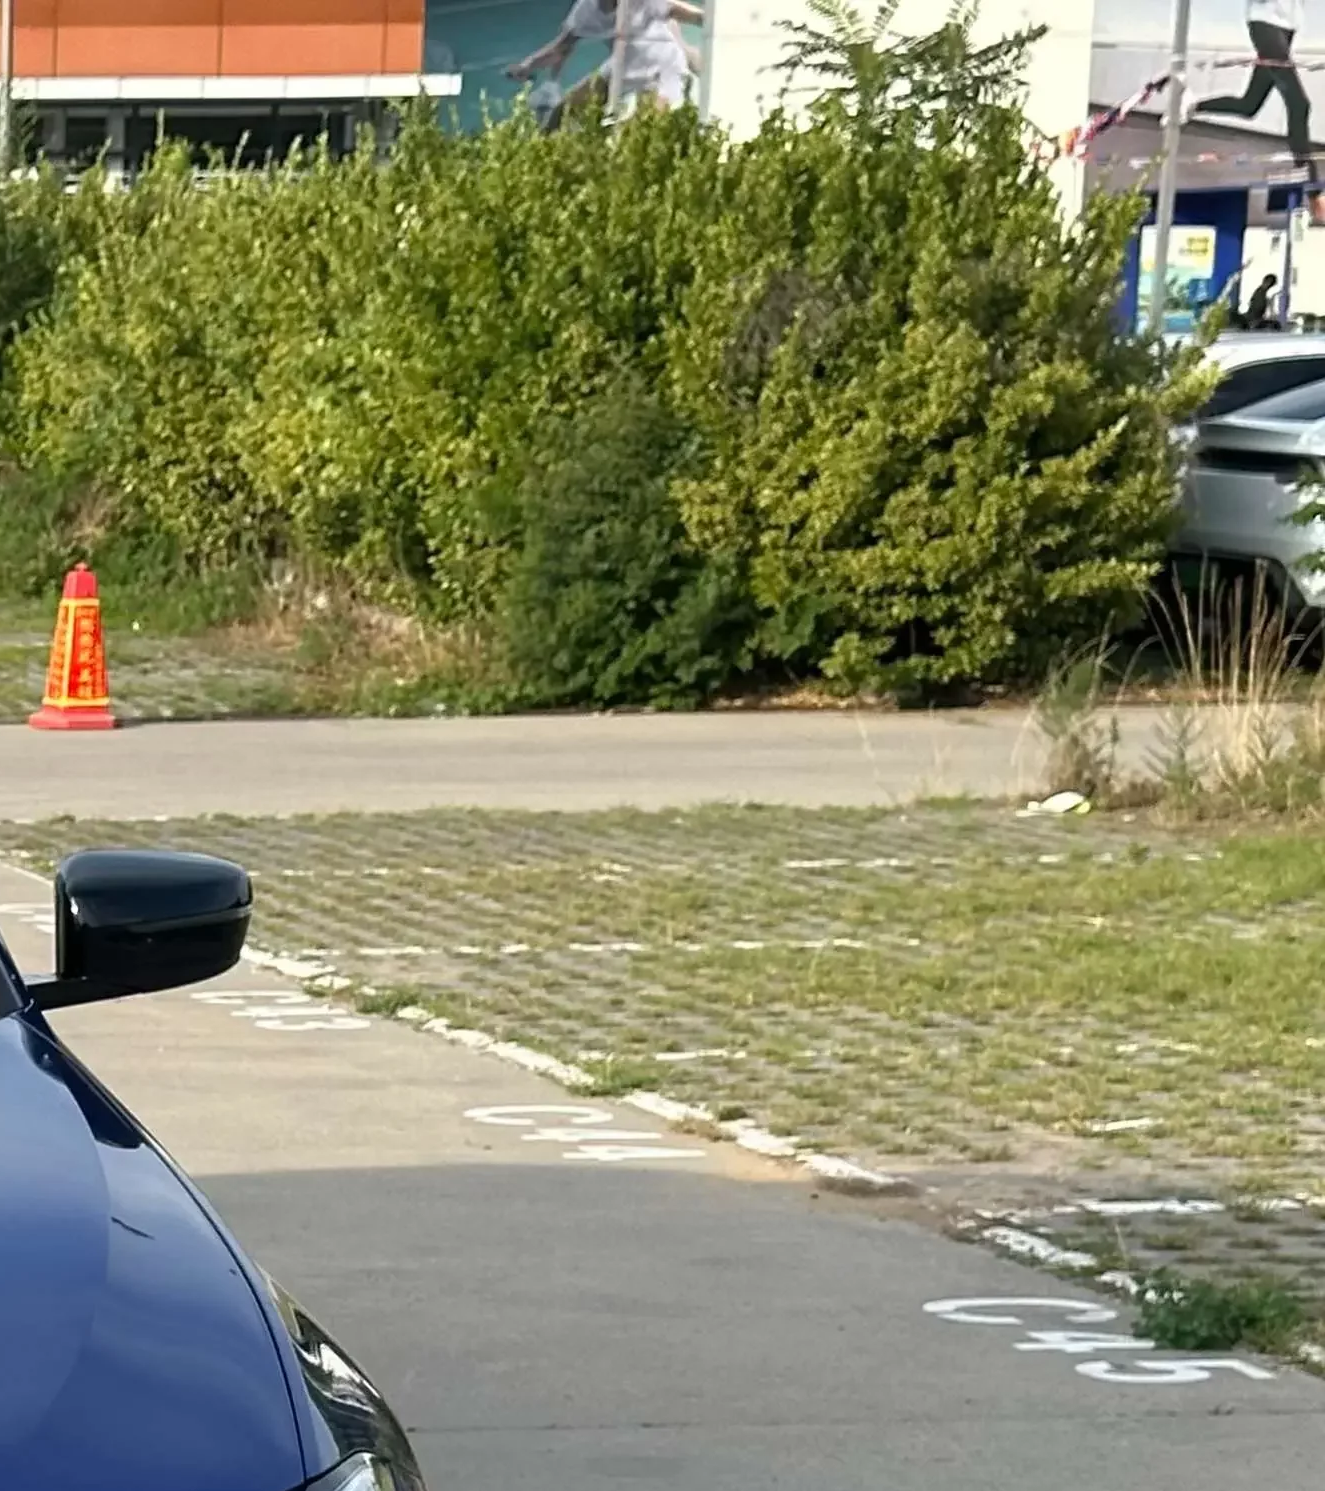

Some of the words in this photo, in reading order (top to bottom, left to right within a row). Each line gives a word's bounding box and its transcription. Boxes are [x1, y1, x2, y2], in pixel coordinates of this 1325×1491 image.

[189, 989, 372, 1031] C43
[462, 1104, 707, 1162] C44
[922, 1296, 1275, 1385] C45
